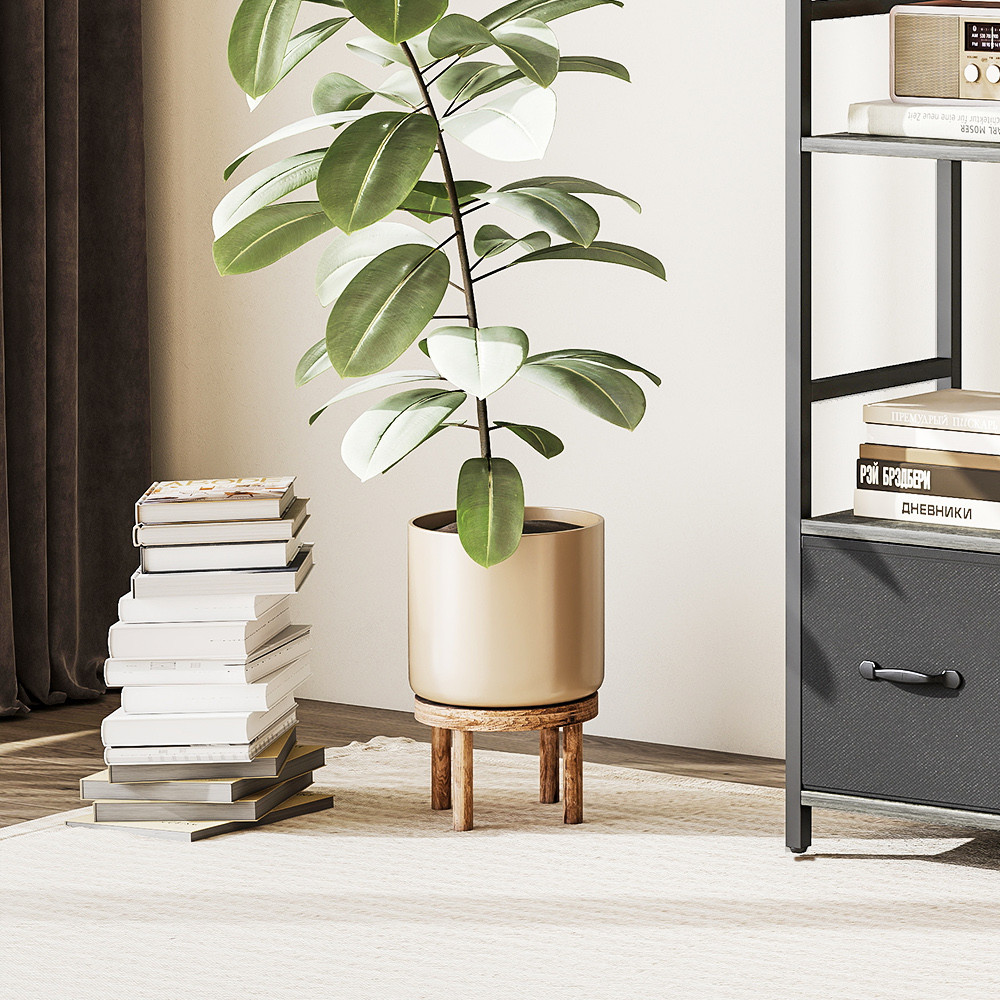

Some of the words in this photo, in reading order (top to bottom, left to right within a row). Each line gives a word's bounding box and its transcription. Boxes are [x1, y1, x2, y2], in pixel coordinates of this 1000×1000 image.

[907, 111, 922, 121] Zeit
[922, 112, 939, 121] neue
[941, 113, 956, 122] eine
[957, 114, 968, 123] für
[960, 124, 986, 135] MOSER
[891, 411, 949, 426] ПРЕМУДРЫЙ
[952, 416, 998, 431] ПИСКАРЬ
[859, 461, 880, 485] РЭЙ
[882, 466, 931, 490] БРЭДБЕРИ
[901, 501, 972, 520] ДНЕВНИКИ
